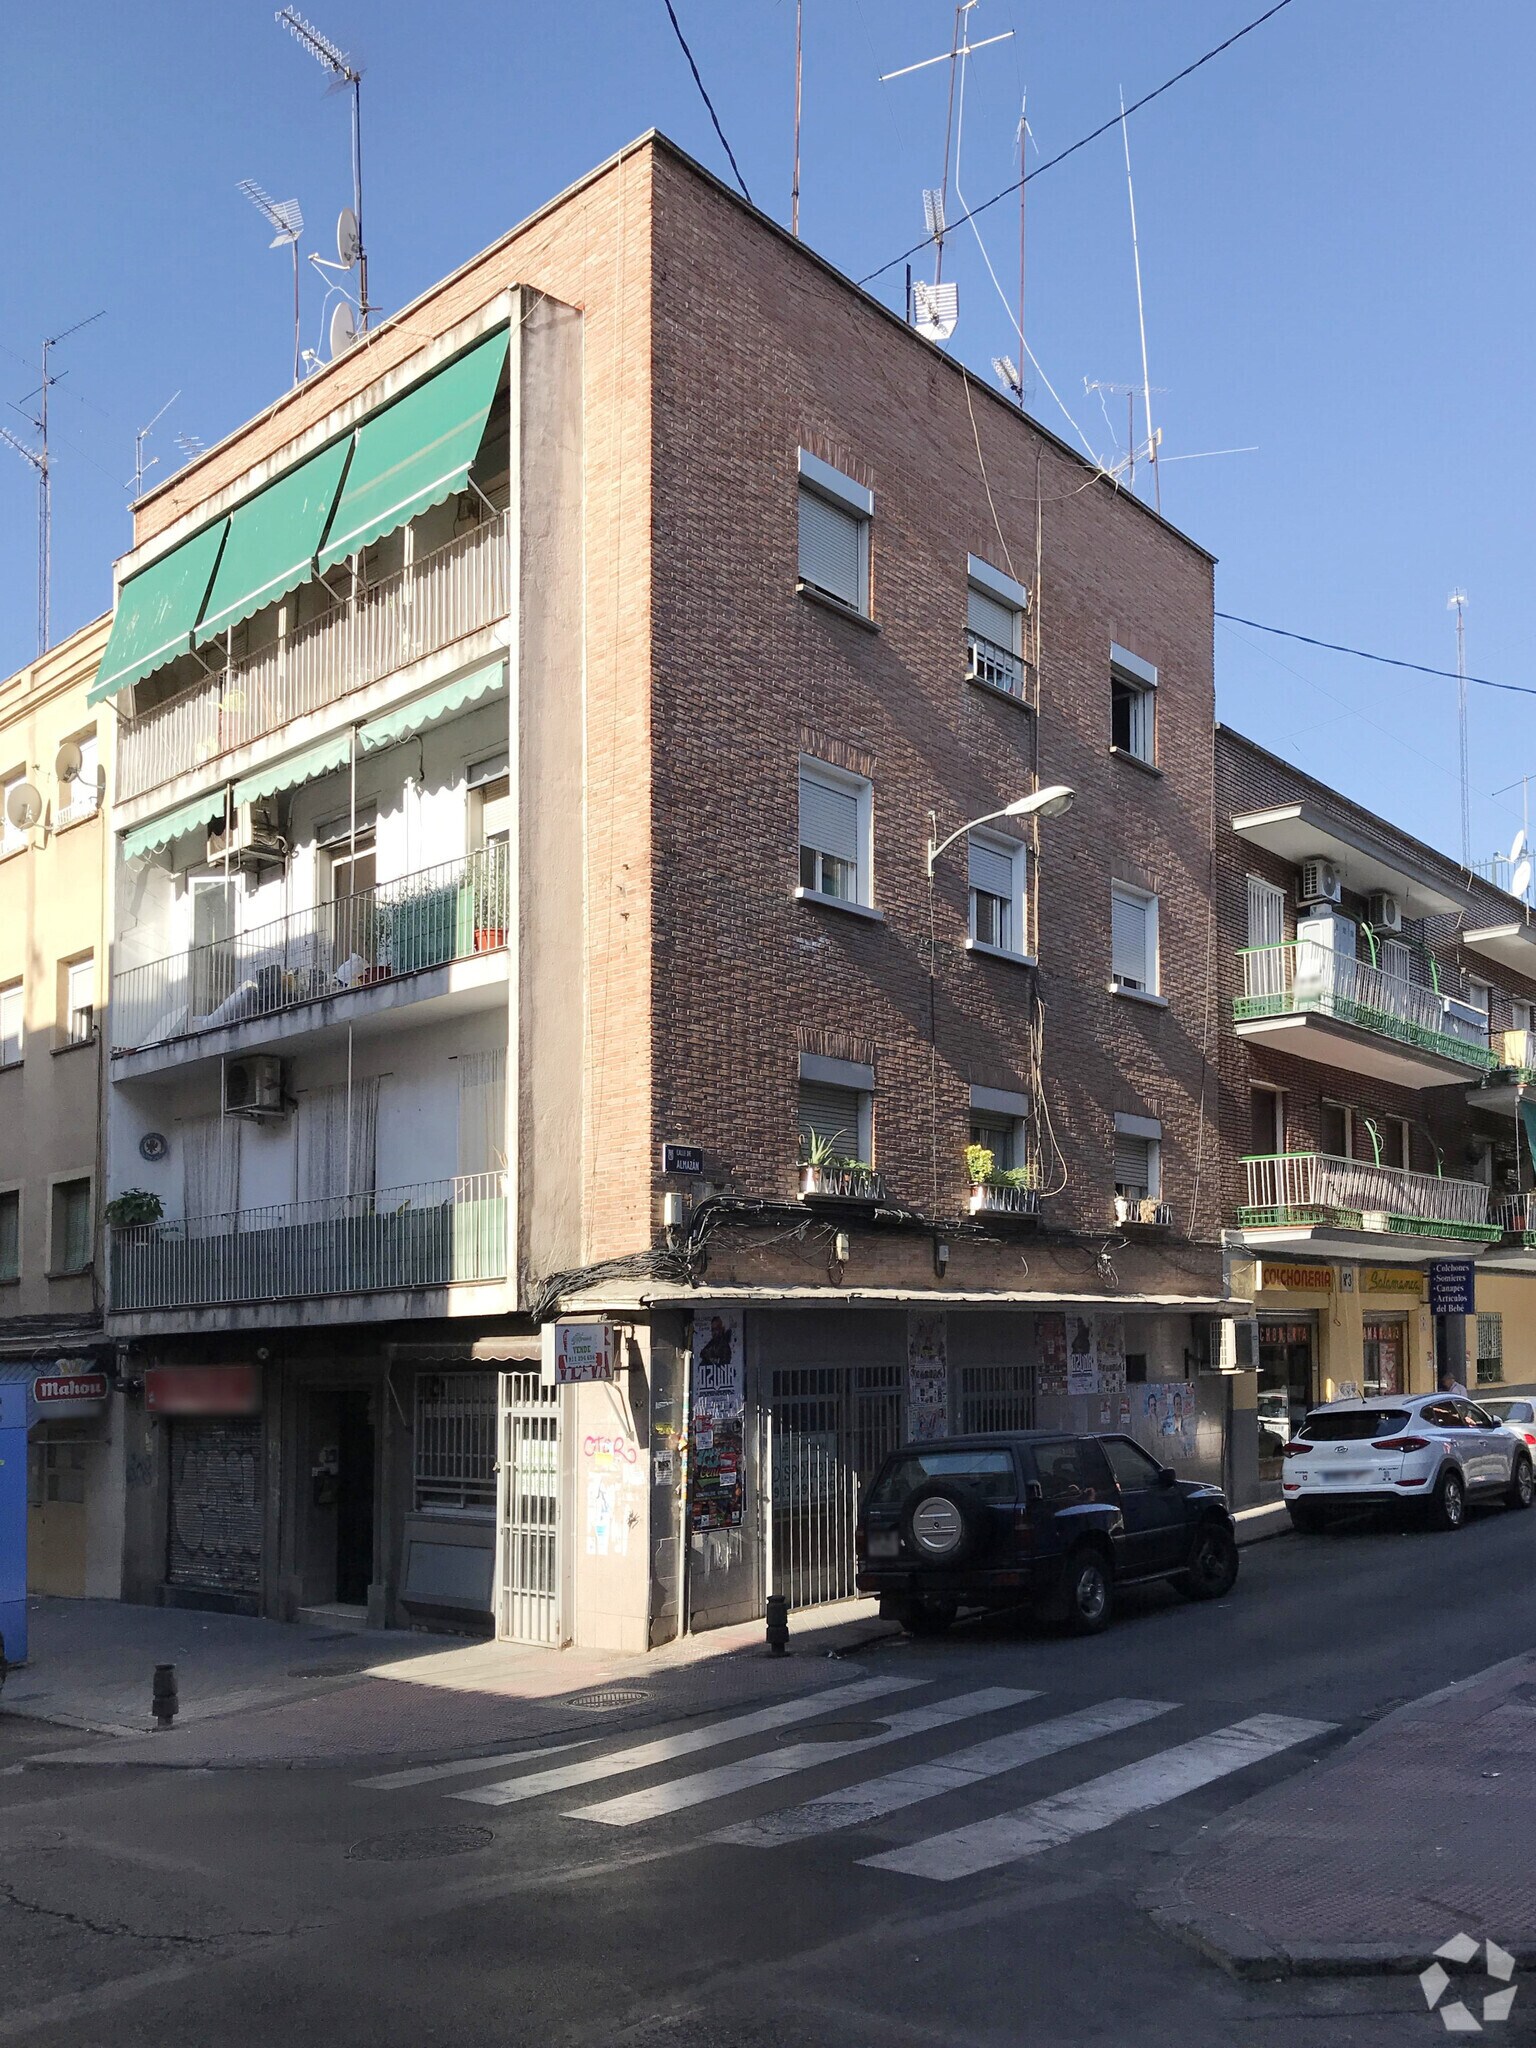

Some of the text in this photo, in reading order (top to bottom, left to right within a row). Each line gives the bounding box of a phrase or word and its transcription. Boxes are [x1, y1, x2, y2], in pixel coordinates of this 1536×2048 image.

[676, 1159, 700, 1170] ALMAZÁN
[1436, 1264, 1470, 1272] Colchones
[1263, 1268, 1331, 1288] COLCHONERIA
[1369, 1270, 1421, 1290] Salamanca
[1436, 1274, 1466, 1282] Somieres
[1436, 1283, 1464, 1293] Canapés
[1436, 1304, 1465, 1312] del Bebé
[572, 1345, 592, 1354] VENDE
[698, 1364, 735, 1388] OZUNA
[41, 1380, 102, 1397] Mahou
